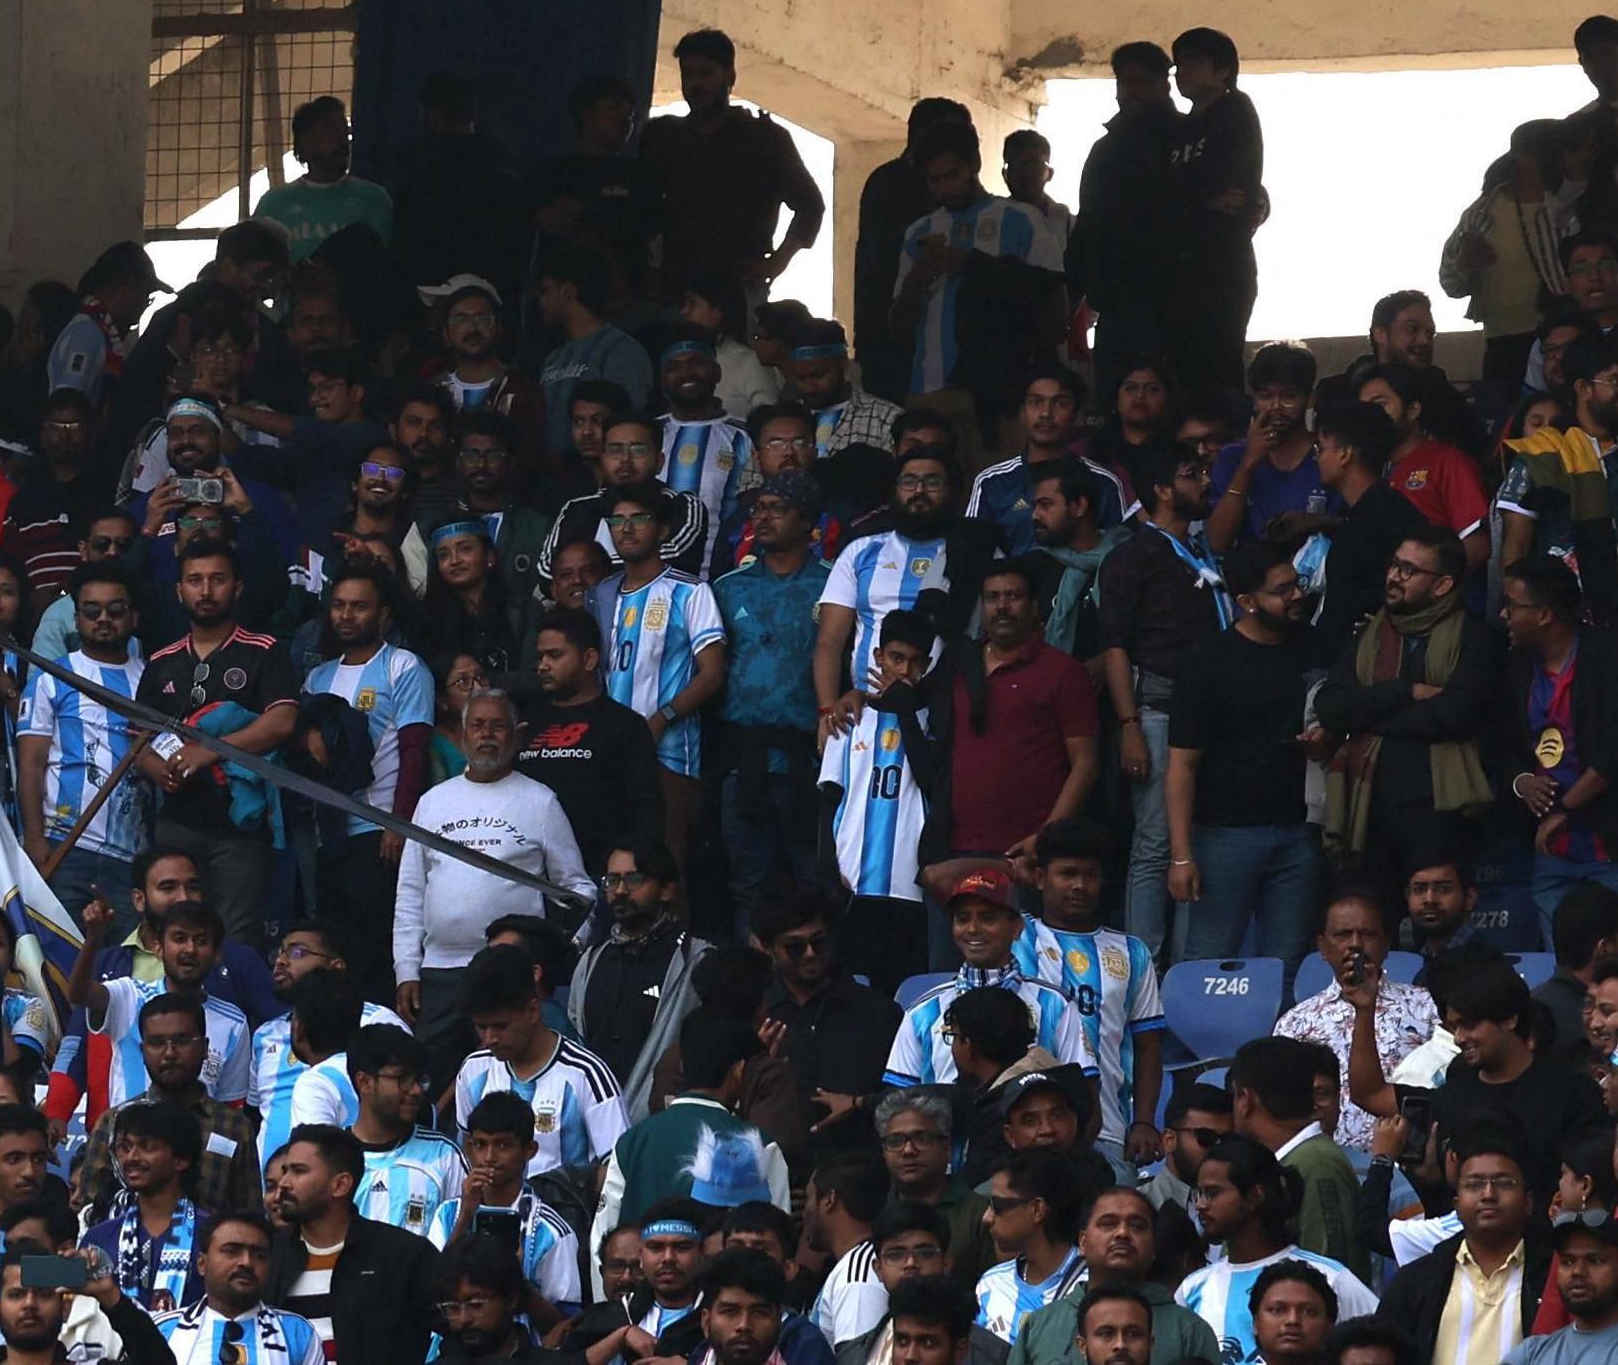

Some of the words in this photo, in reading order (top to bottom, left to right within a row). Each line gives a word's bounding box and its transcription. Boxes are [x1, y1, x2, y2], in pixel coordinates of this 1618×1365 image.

[518, 750, 540, 762] new
[540, 747, 593, 760] balance
[872, 764, 902, 799] 10
[1204, 976, 1251, 996] 7246
